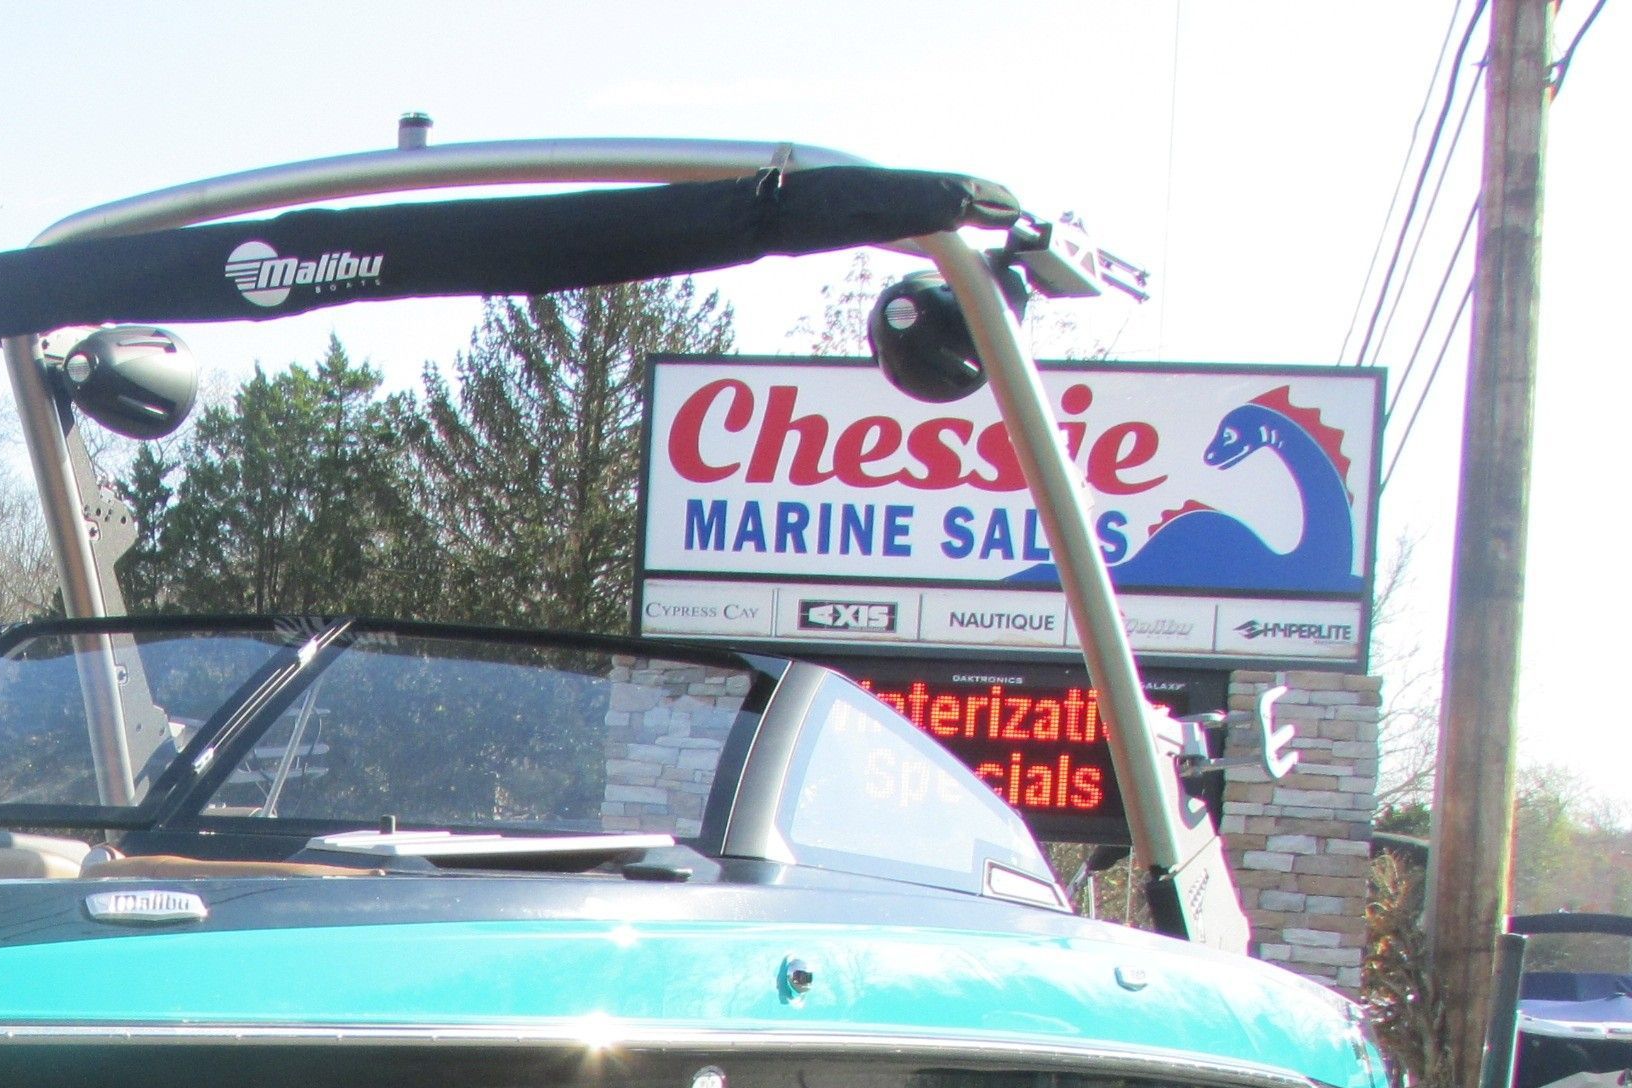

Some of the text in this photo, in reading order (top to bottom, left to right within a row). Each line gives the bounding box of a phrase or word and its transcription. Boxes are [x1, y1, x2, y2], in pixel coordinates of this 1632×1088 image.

[257, 252, 384, 288] Malibu
[684, 498, 1128, 565] MARINE SALS
[808, 603, 889, 627] AXIS
[949, 611, 1056, 631] NAUTIQUE
[1126, 616, 1194, 635] alibu
[1263, 622, 1352, 640] HYPERLITE
[952, 674, 1024, 685] DAKTRONICS
[1145, 681, 1187, 691] ALAXY
[113, 894, 190, 912] Malibu
